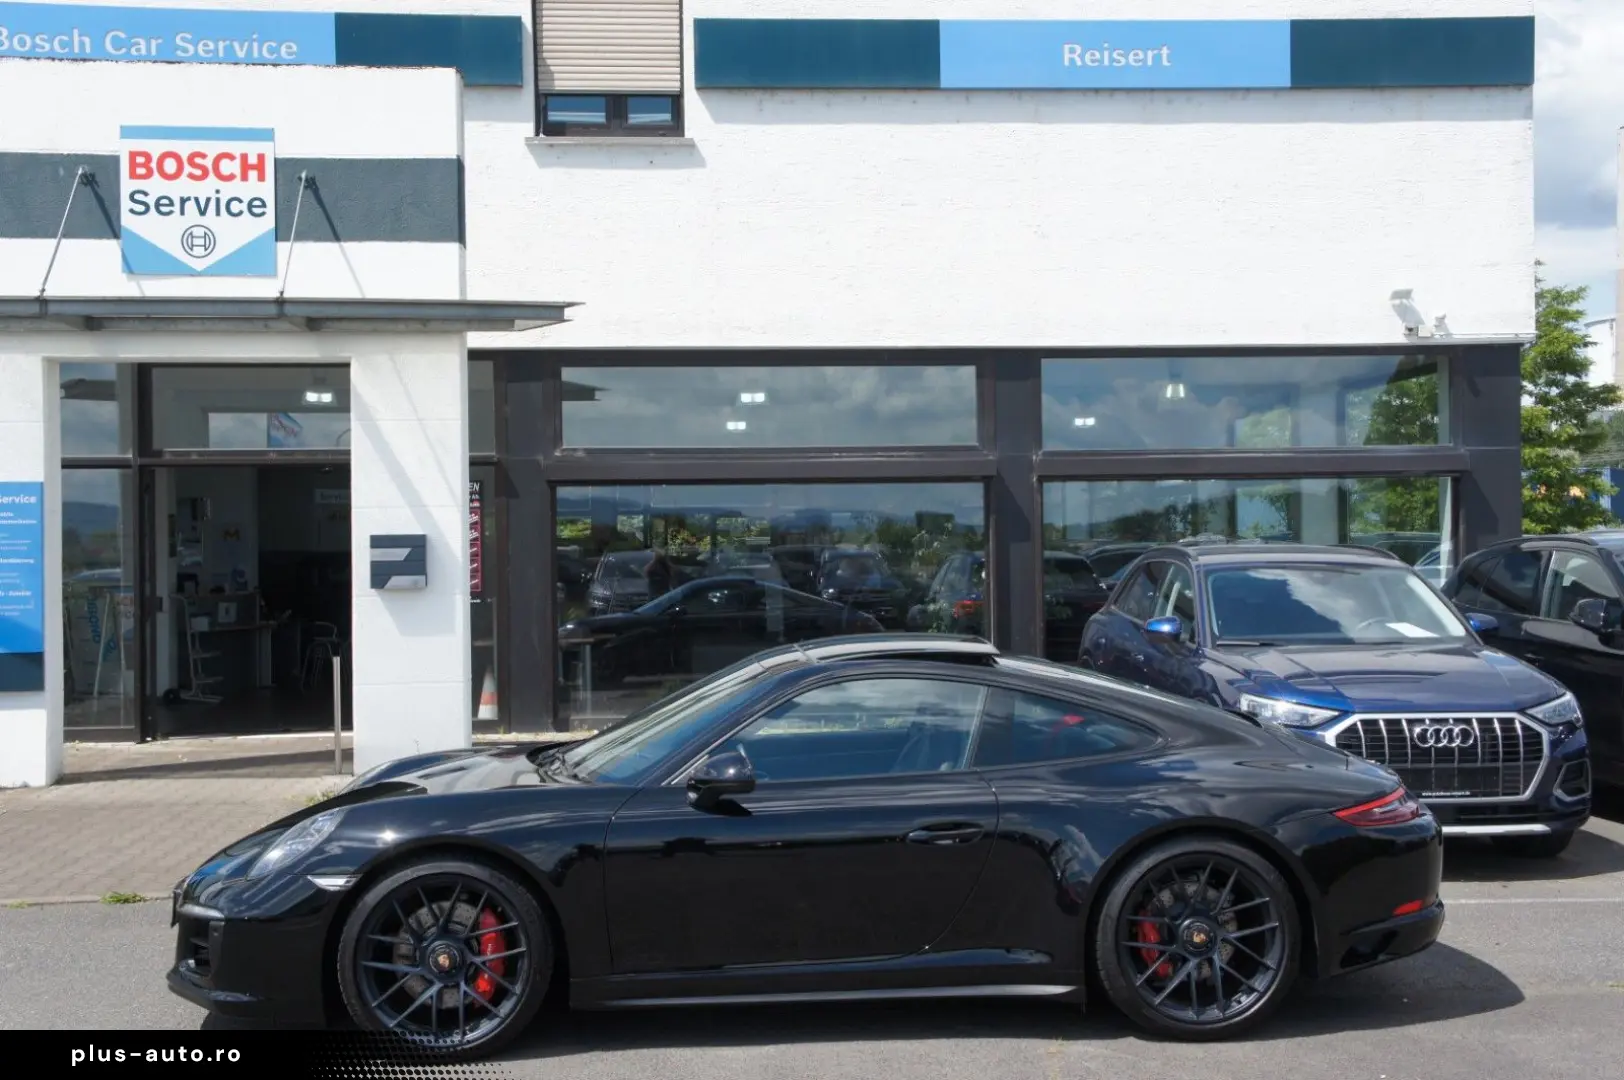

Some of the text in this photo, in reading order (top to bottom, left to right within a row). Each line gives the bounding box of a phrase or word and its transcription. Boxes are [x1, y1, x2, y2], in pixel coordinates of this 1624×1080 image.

[0, 26, 299, 60] Bosch Car Service
[1062, 42, 1172, 67] Reisert
[128, 150, 266, 183] BOSCH
[128, 189, 267, 218] Service
